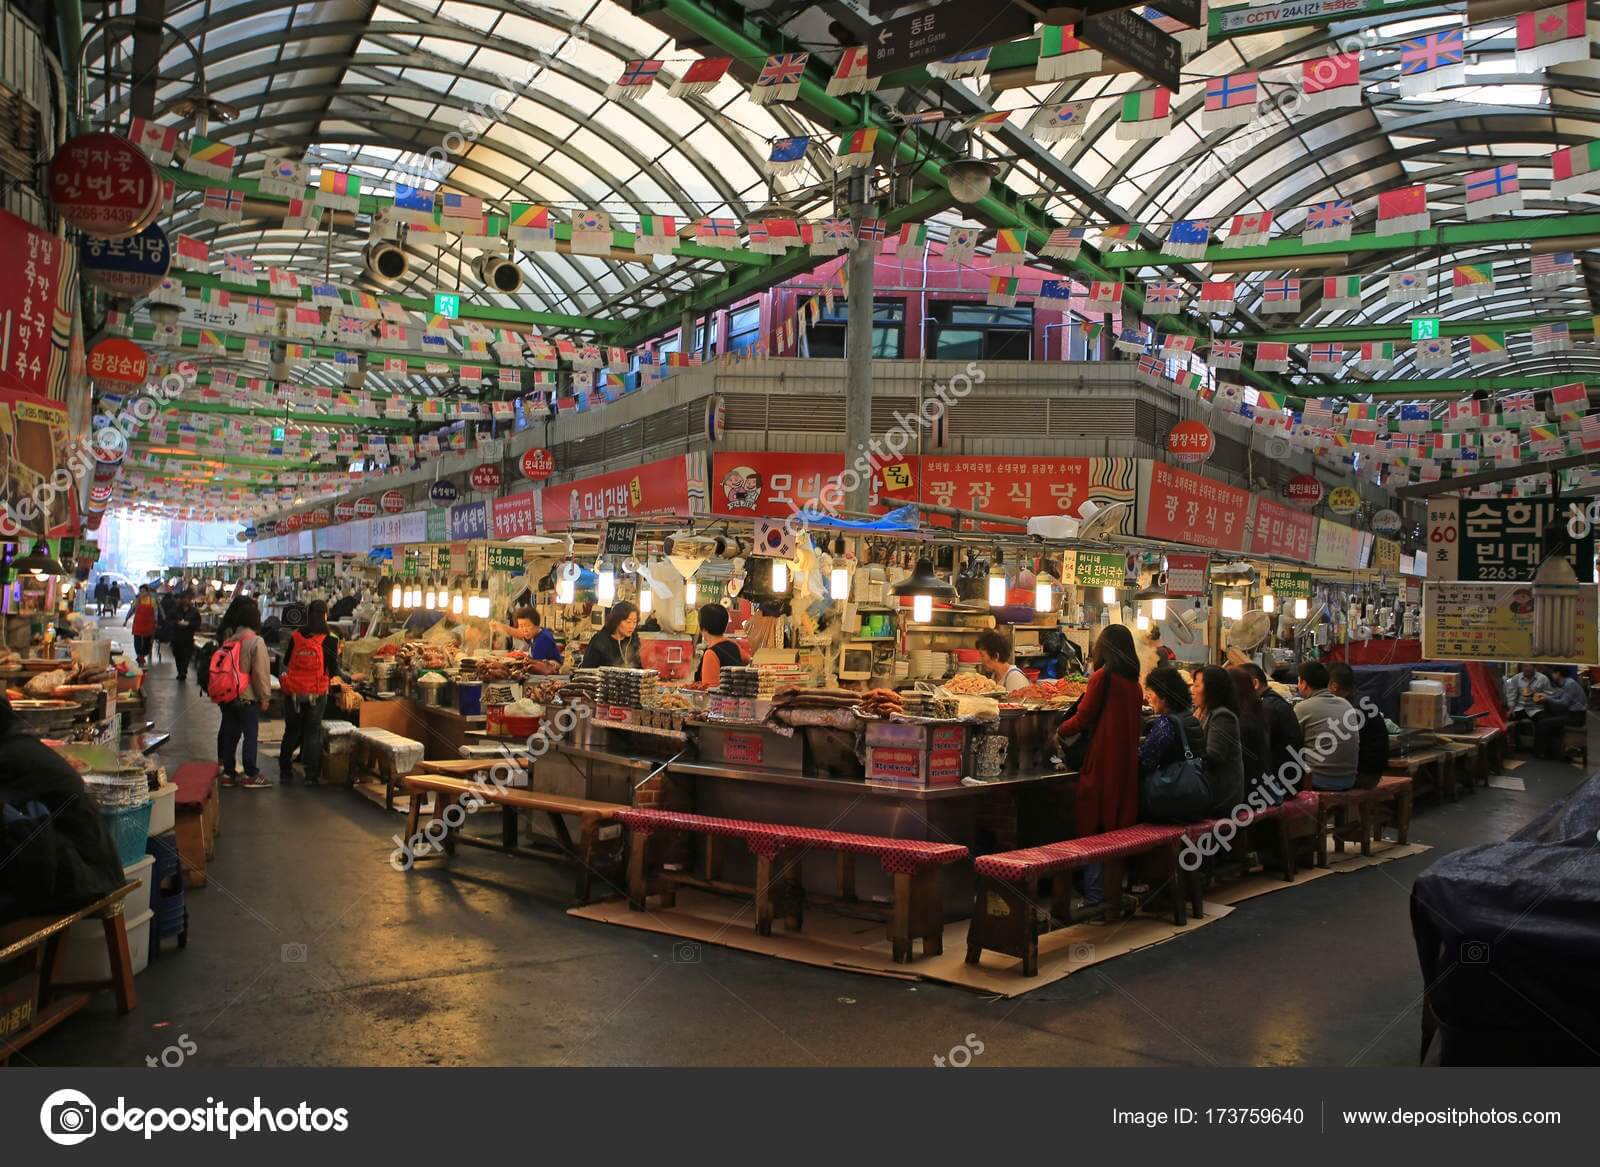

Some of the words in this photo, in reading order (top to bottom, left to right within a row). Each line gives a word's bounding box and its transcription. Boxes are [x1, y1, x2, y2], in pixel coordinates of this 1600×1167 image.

[910, 14, 937, 36] 동문
[1246, 9, 1281, 24] CCTV
[1282, 4, 1321, 18] 24시간
[908, 37, 926, 49] East
[927, 31, 947, 44] Gate
[71, 147, 133, 172] 먹자골
[54, 171, 145, 205] 일번지
[92, 352, 146, 378] 광장순대
[1169, 431, 1209, 449] 광장식당
[584, 483, 629, 519] 모녀김밥
[929, 479, 1078, 511] 광장식당
[452, 505, 487, 535] 유성쉼터
[495, 509, 533, 535] 대광정육점
[1164, 494, 1236, 536] 광장식당
[607, 526, 634, 542] 자선네
[1430, 526, 1457, 544] 60
[1435, 548, 1449, 562] 호
[1077, 563, 1092, 576] 순대
[1094, 564, 1124, 579] 잔치국수
